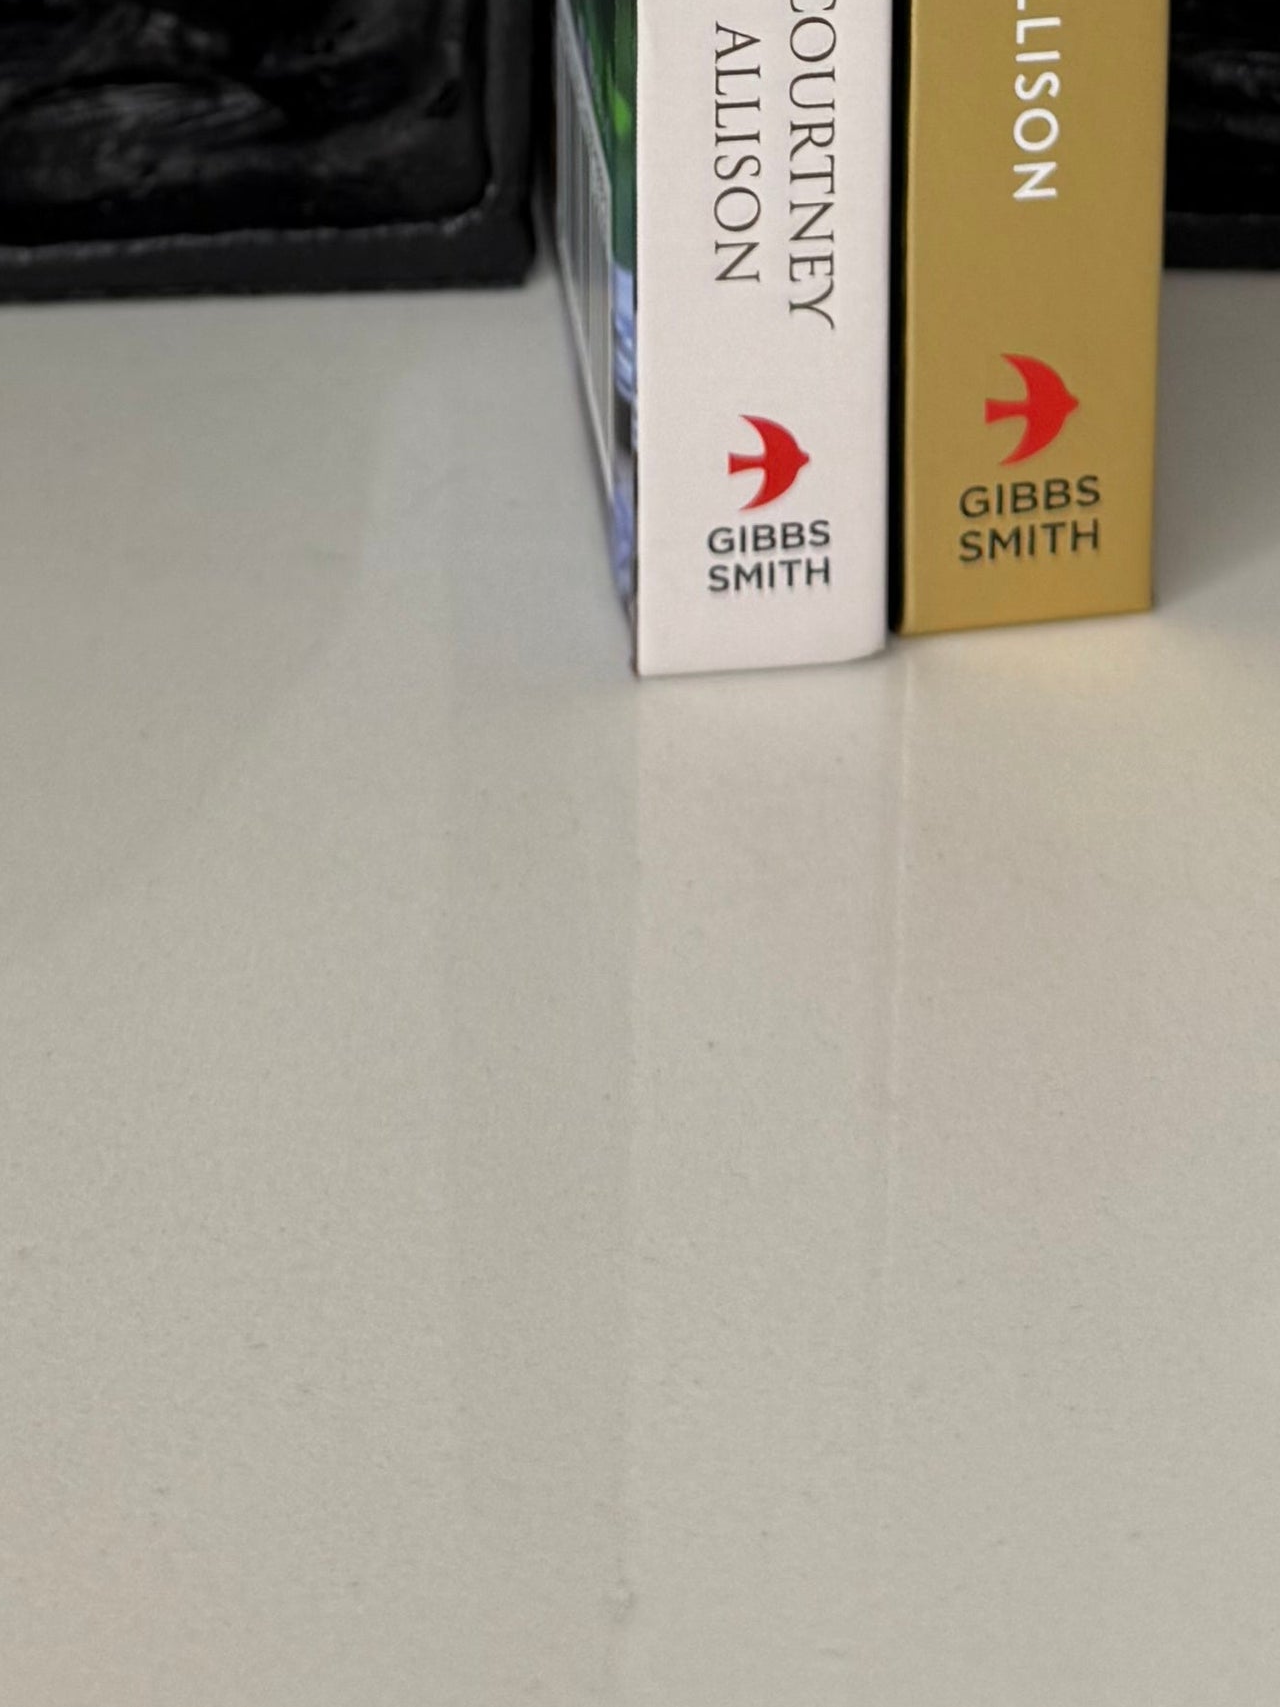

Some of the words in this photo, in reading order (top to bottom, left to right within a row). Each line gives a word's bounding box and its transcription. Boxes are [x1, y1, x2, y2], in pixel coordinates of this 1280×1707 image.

[713, 21, 762, 282] ALLISON
[959, 475, 1101, 518] GIBBS
[707, 519, 831, 555] GIBBS
[959, 519, 1099, 563] SMITH
[709, 556, 830, 593] SMITH
